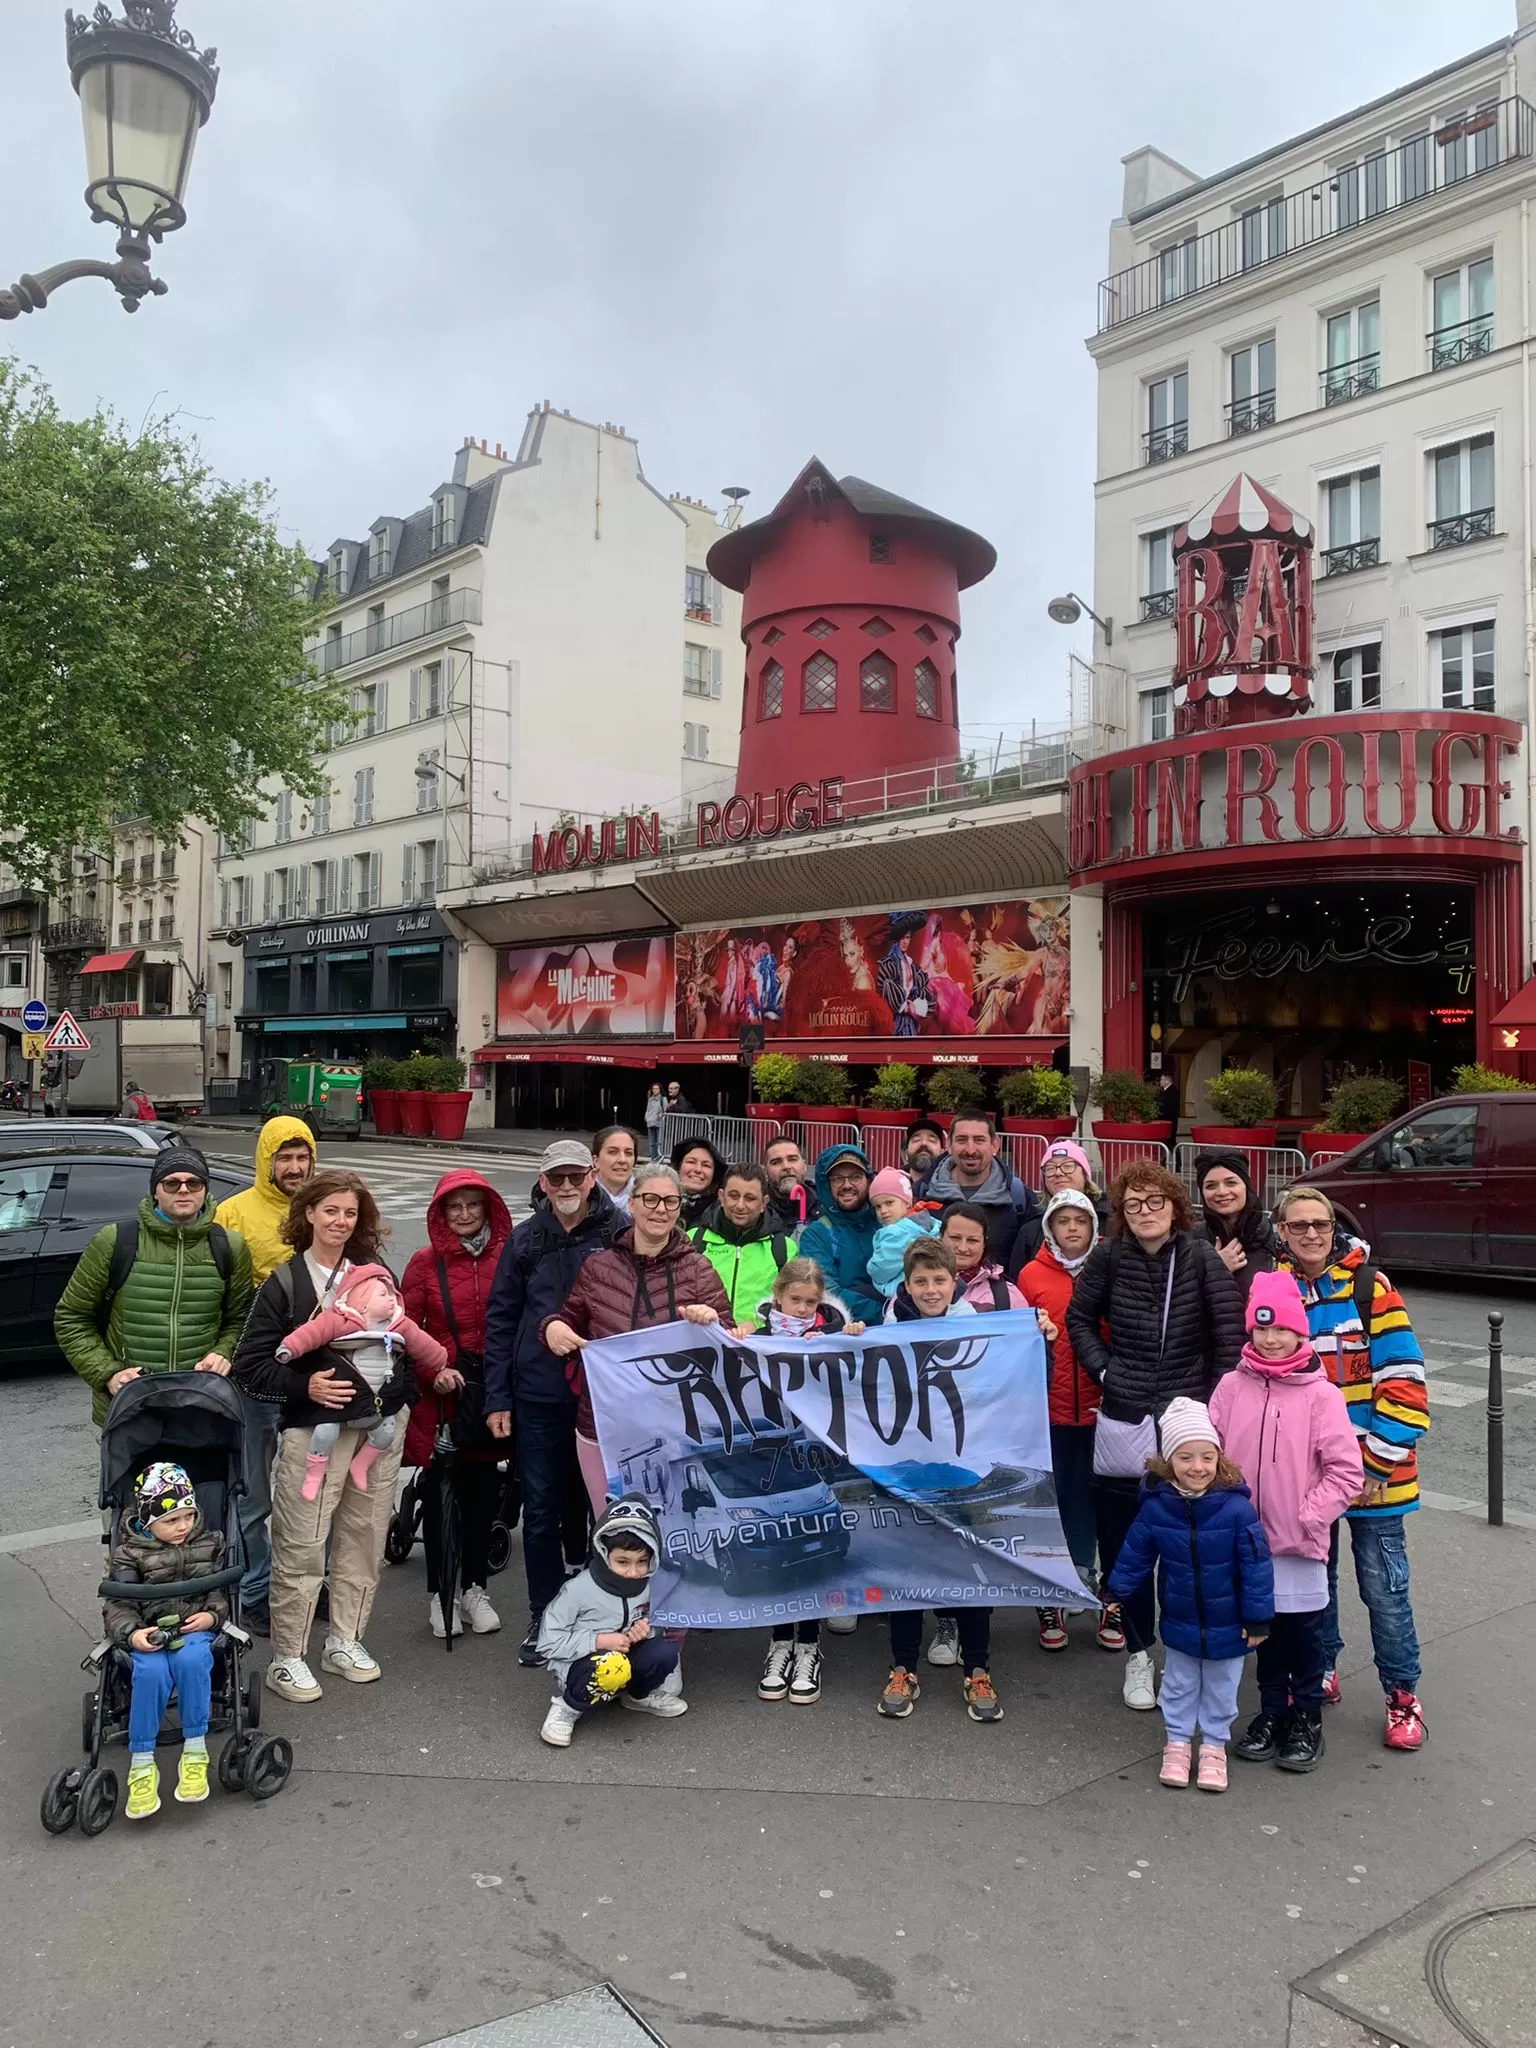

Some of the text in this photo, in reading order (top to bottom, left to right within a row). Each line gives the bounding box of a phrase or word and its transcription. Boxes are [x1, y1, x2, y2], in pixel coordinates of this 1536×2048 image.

[1176, 699, 1229, 735] DU
[1225, 729, 1523, 846] ROUGE
[532, 776, 844, 873] MOULIN ROUGE
[306, 923, 370, 946] O'SULLIVANS
[396, 920, 406, 935] By
[416, 915, 431, 930] Mill
[548, 969, 557, 983] LA
[809, 1010, 869, 1027] MOULIN ROUGE
[821, 996, 858, 1014] Forever
[933, 1054, 979, 1063] MOULIN ROUGE
[620, 1334, 1006, 1458] RAPTOR
[749, 1436, 843, 1491] Trav
[665, 1511, 859, 1559] Avventure
[870, 1500, 901, 1529] in
[654, 1593, 821, 1627] Seguici sui social
